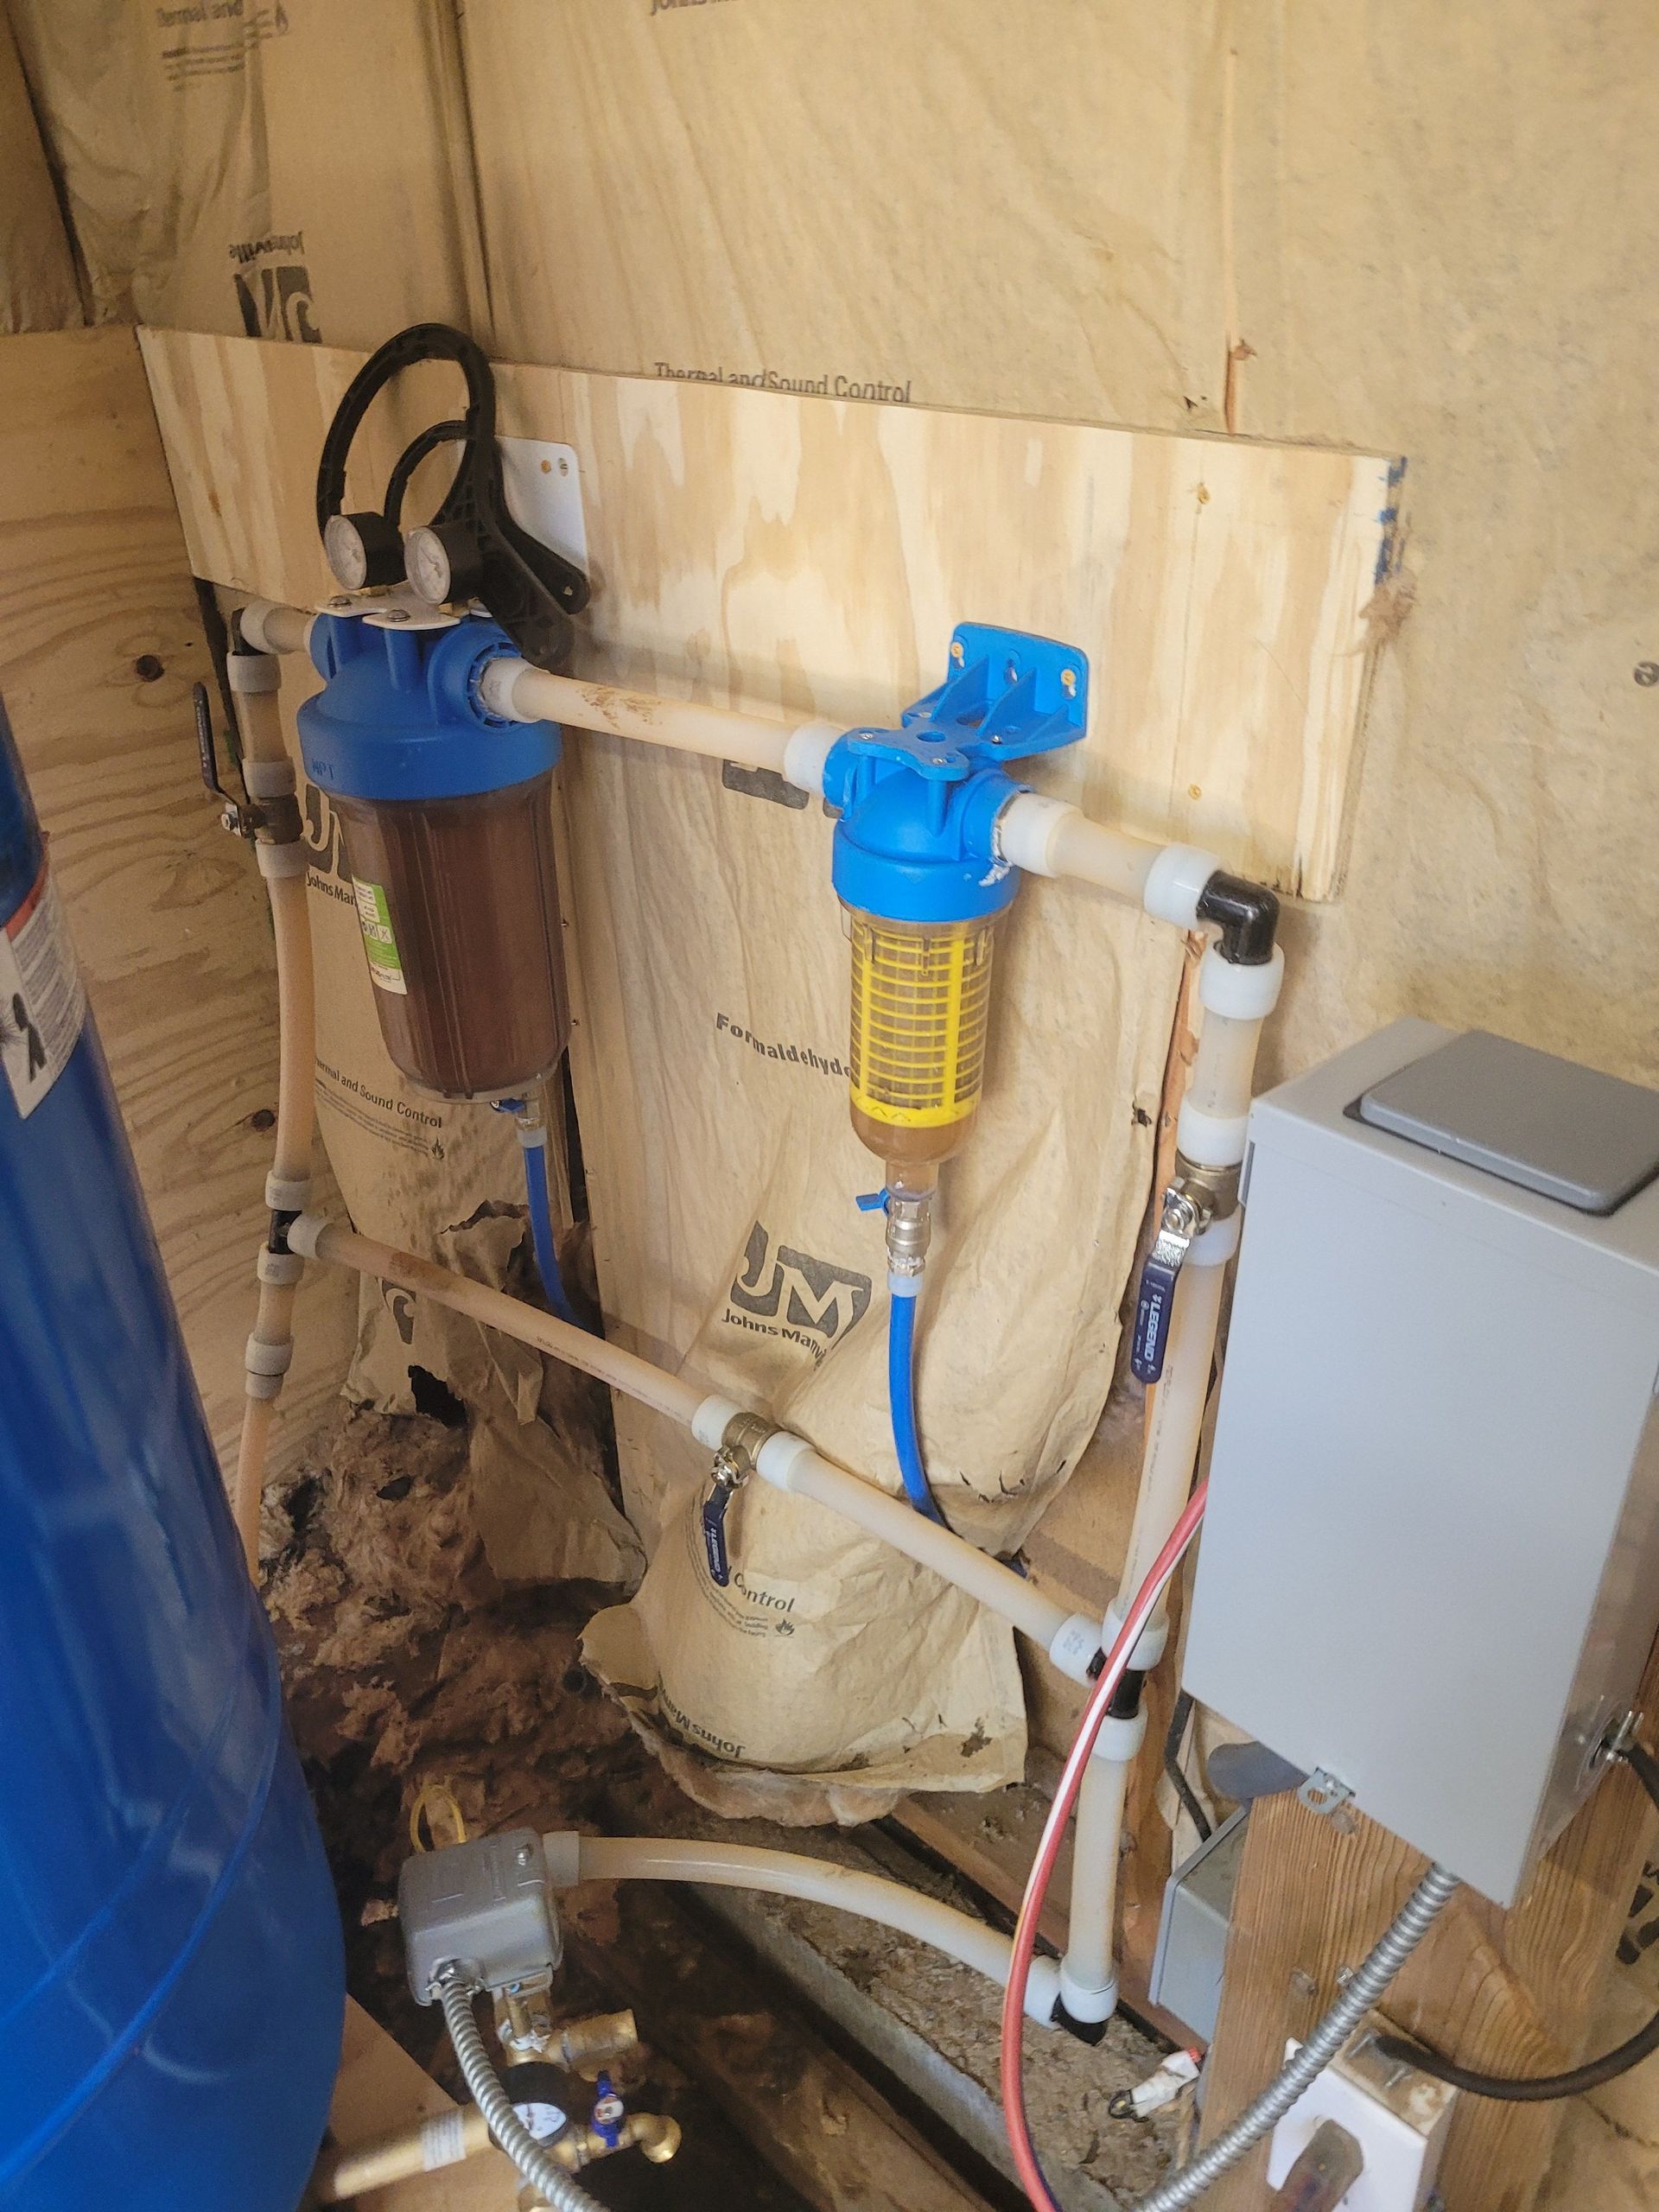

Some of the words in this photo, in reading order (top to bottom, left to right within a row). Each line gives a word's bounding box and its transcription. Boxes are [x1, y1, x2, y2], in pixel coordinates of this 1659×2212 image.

[834, 375, 912, 404] Control
[307, 873, 334, 897] Johns
[341, 1076, 359, 1093] and
[359, 1084, 394, 1111] Sound
[397, 1101, 443, 1128] Control
[721, 1307, 779, 1336] Johns
[1144, 1300, 1161, 1363] LEGEND
[692, 1723, 747, 1759] Johns
